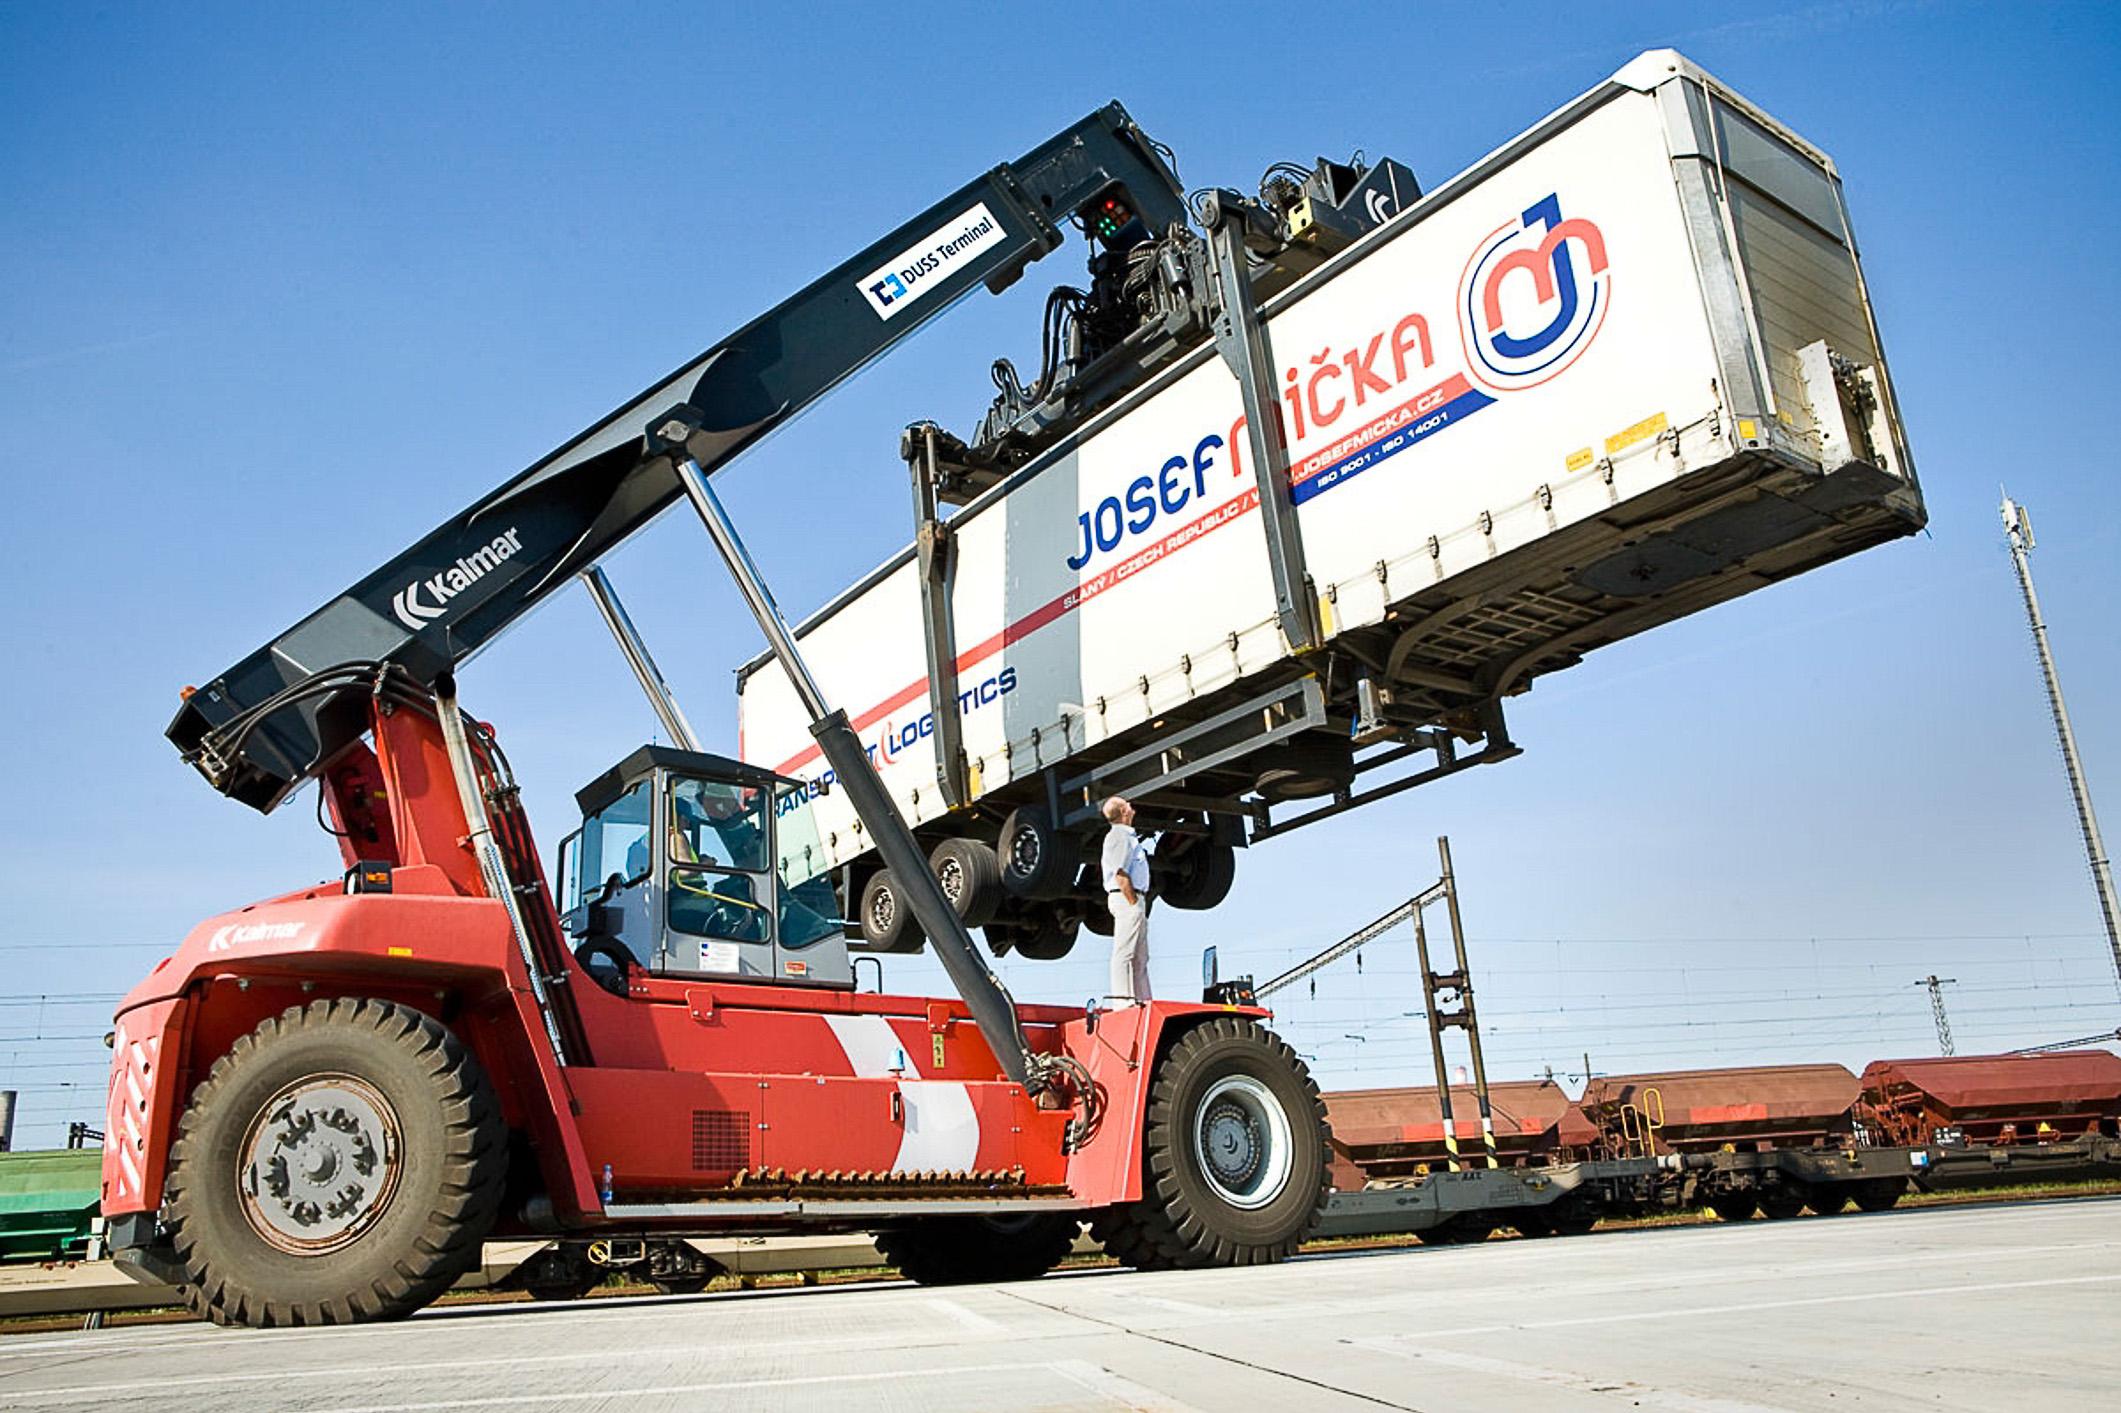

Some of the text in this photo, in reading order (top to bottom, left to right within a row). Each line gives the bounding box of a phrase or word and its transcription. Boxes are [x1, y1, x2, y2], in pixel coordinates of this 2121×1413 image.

[900, 216, 994, 284] DUSS Terminal
[1317, 469, 1338, 489] ISO
[1382, 436, 1405, 454] ISO
[1407, 411, 1449, 440] 14001
[1066, 434, 1224, 571] JOSEF
[1117, 544, 1165, 579] CZECH
[1166, 504, 1240, 551] REPUBLIC
[424, 526, 523, 605] Kalmar
[889, 666, 1017, 755] LOGTICS
[231, 921, 305, 945] Kalmar
